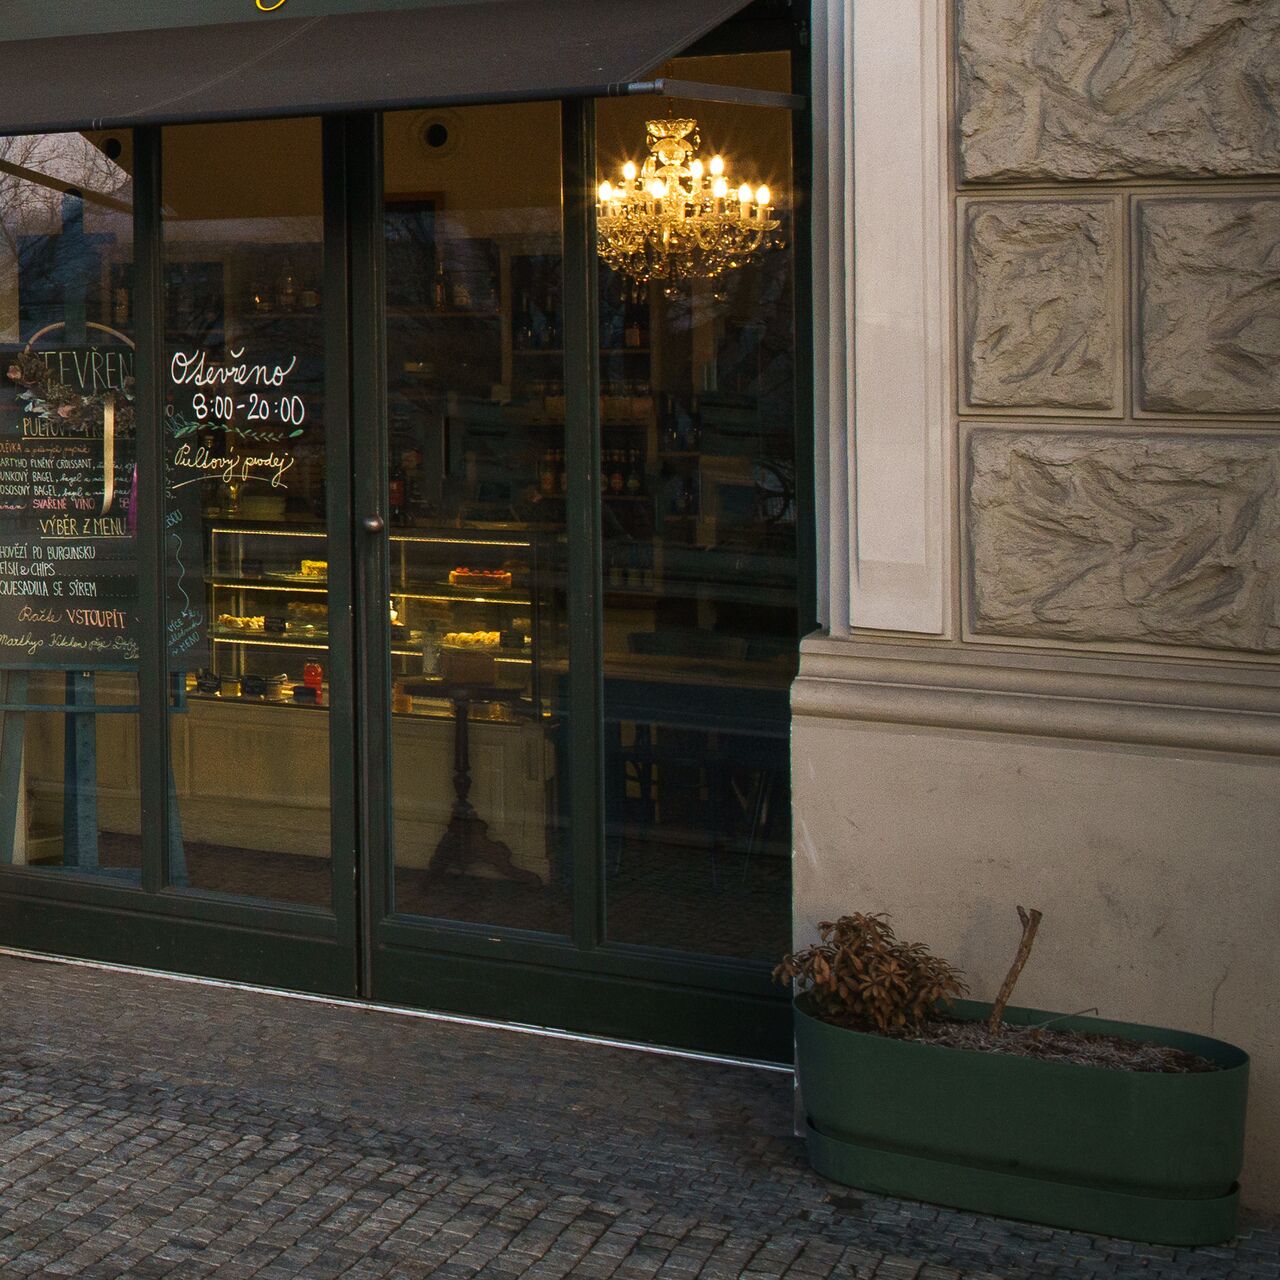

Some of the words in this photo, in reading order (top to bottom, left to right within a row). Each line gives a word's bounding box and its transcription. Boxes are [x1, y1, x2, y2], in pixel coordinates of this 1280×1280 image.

[37, 346, 134, 389] TEVŘEN
[171, 347, 297, 387] Otevřeno
[174, 443, 240, 483] Pultový
[241, 452, 294, 488] prodej
[39, 514, 79, 536] VÝBĚR
[83, 518, 91, 534] Z
[93, 517, 127, 536] MENU
[0, 542, 28, 559] HOVĚZÍ
[32, 545, 43, 560] PO
[53, 581, 64, 597] SE
[69, 579, 97, 597] SÝREM
